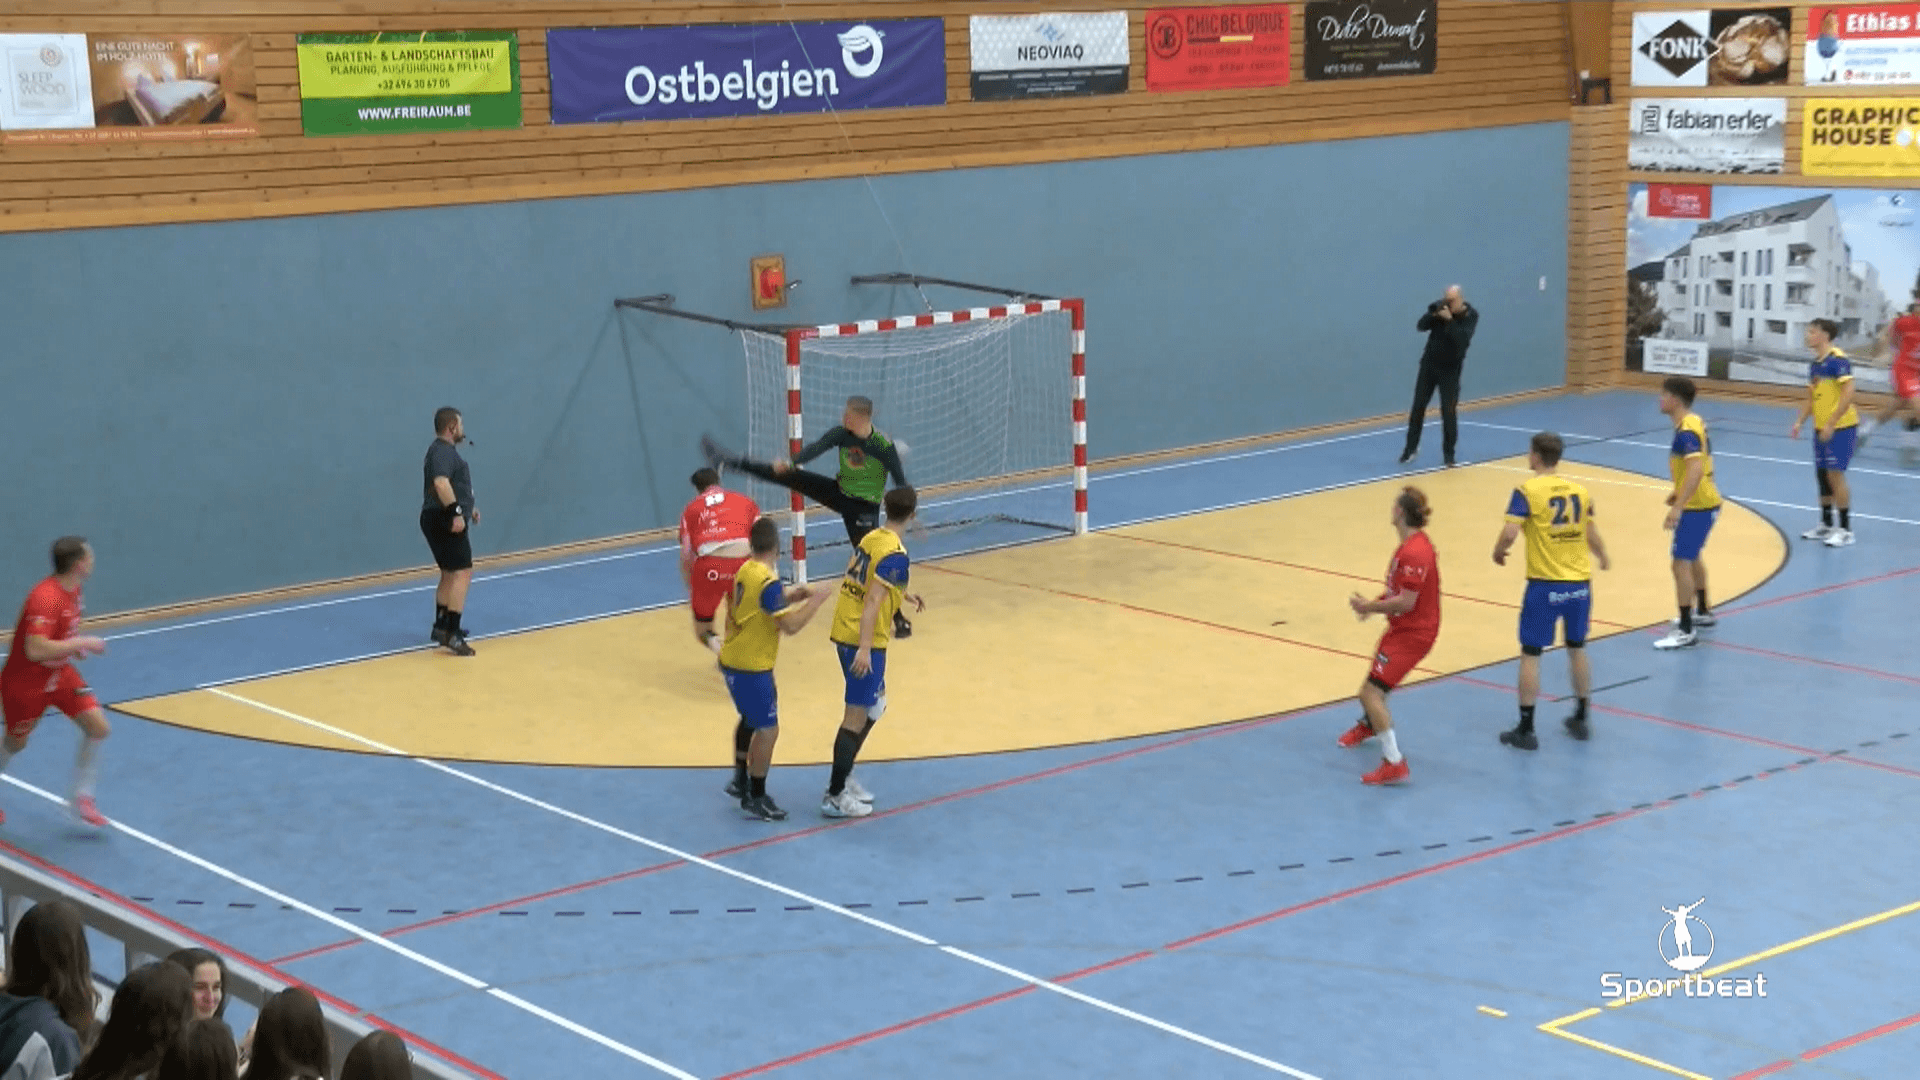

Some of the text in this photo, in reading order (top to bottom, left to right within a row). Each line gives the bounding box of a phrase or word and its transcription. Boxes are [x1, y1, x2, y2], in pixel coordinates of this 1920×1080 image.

[1846, 12, 1911, 32] Ethias
[326, 48, 494, 63] GARTEN- & LANDSCHAFTSBAU
[1018, 44, 1084, 61] NEOVIAQ
[1649, 37, 1709, 59] FONK
[624, 59, 839, 110] Ostbelgien
[358, 104, 471, 120] WWW.FREIRAUM.BE
[1666, 108, 1773, 130] fabian erler
[1813, 106, 1920, 124] GRAPHIC
[1812, 128, 1893, 145] HOUSE
[1549, 493, 1581, 525] 21
